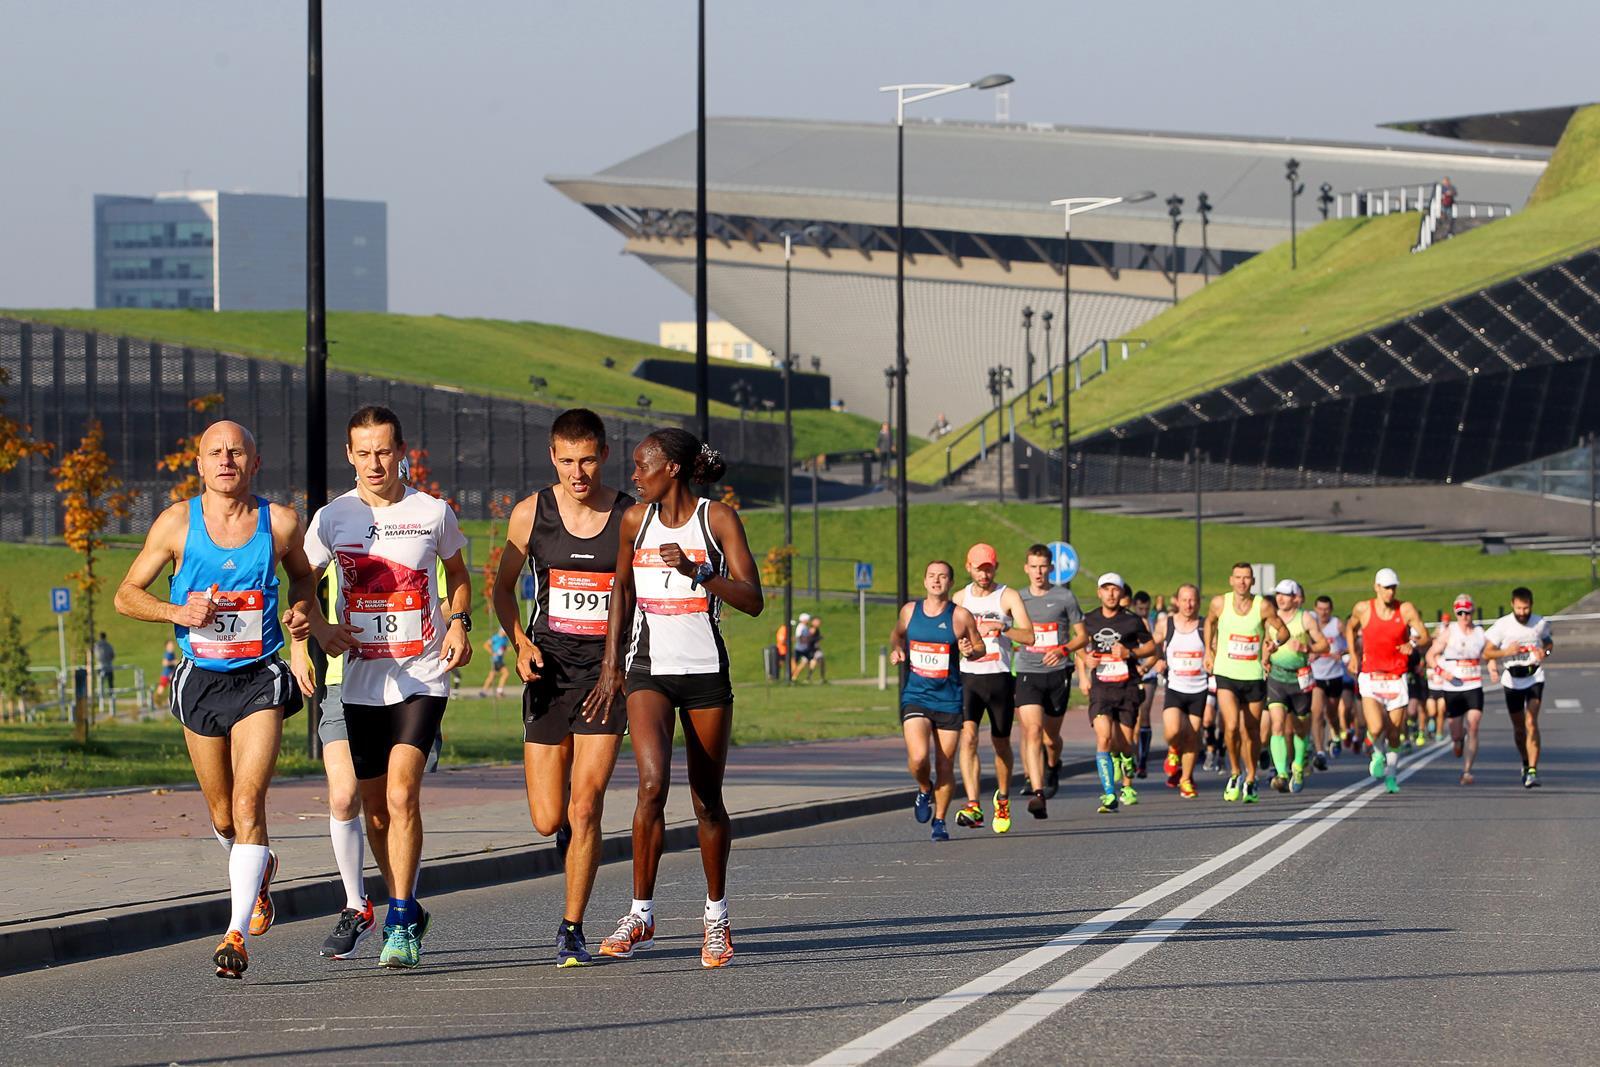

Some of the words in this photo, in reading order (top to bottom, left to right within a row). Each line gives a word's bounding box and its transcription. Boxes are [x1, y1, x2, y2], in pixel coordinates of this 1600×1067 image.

[384, 529, 432, 537] MARATHON
[662, 571, 672, 589] 7
[562, 592, 610, 611] 1991
[214, 614, 239, 633] 57
[372, 614, 398, 633] 18
[919, 653, 939, 665] 106
